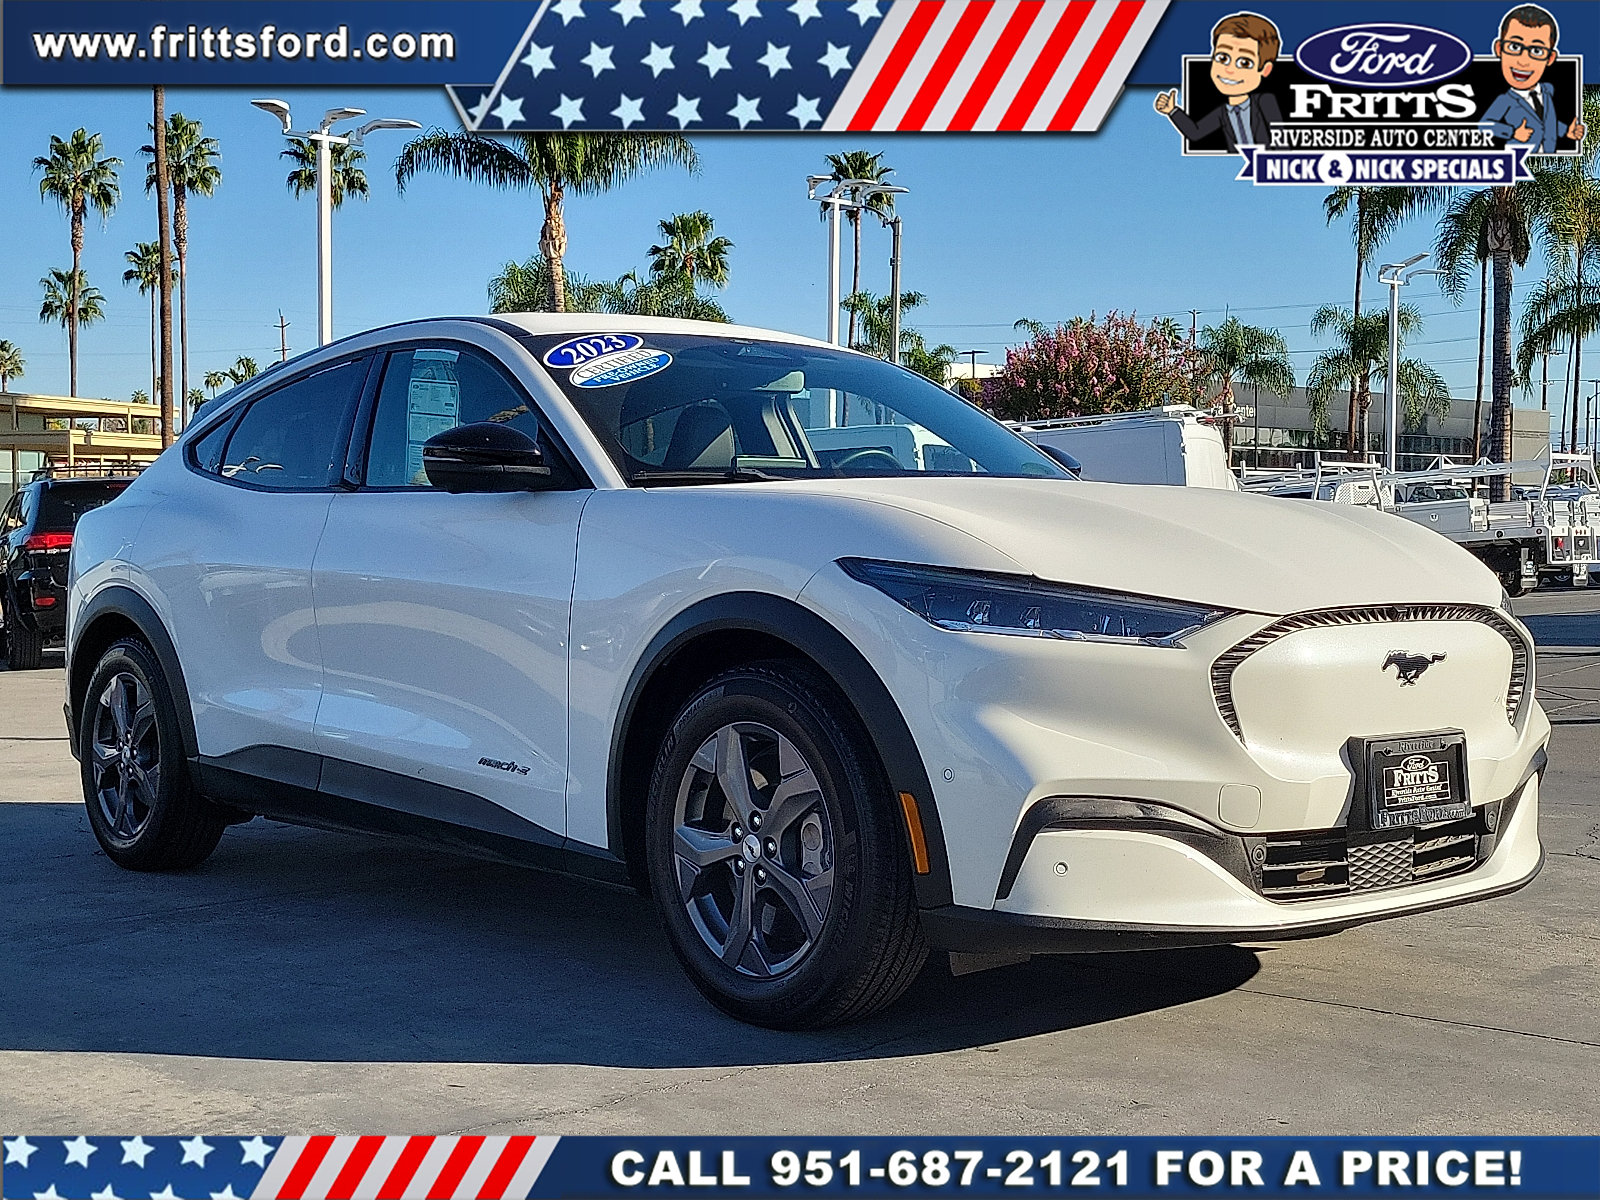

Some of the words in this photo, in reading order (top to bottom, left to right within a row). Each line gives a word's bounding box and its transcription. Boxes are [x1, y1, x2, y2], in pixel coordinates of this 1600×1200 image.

[560, 335, 627, 365] 2023
[577, 350, 652, 379] CERTIFIED
[593, 357, 661, 383] PRE-OWNED
[610, 363, 661, 382] VEHICLE
[1393, 765, 1440, 787] FRITTS
[1406, 758, 1425, 770] Ford
